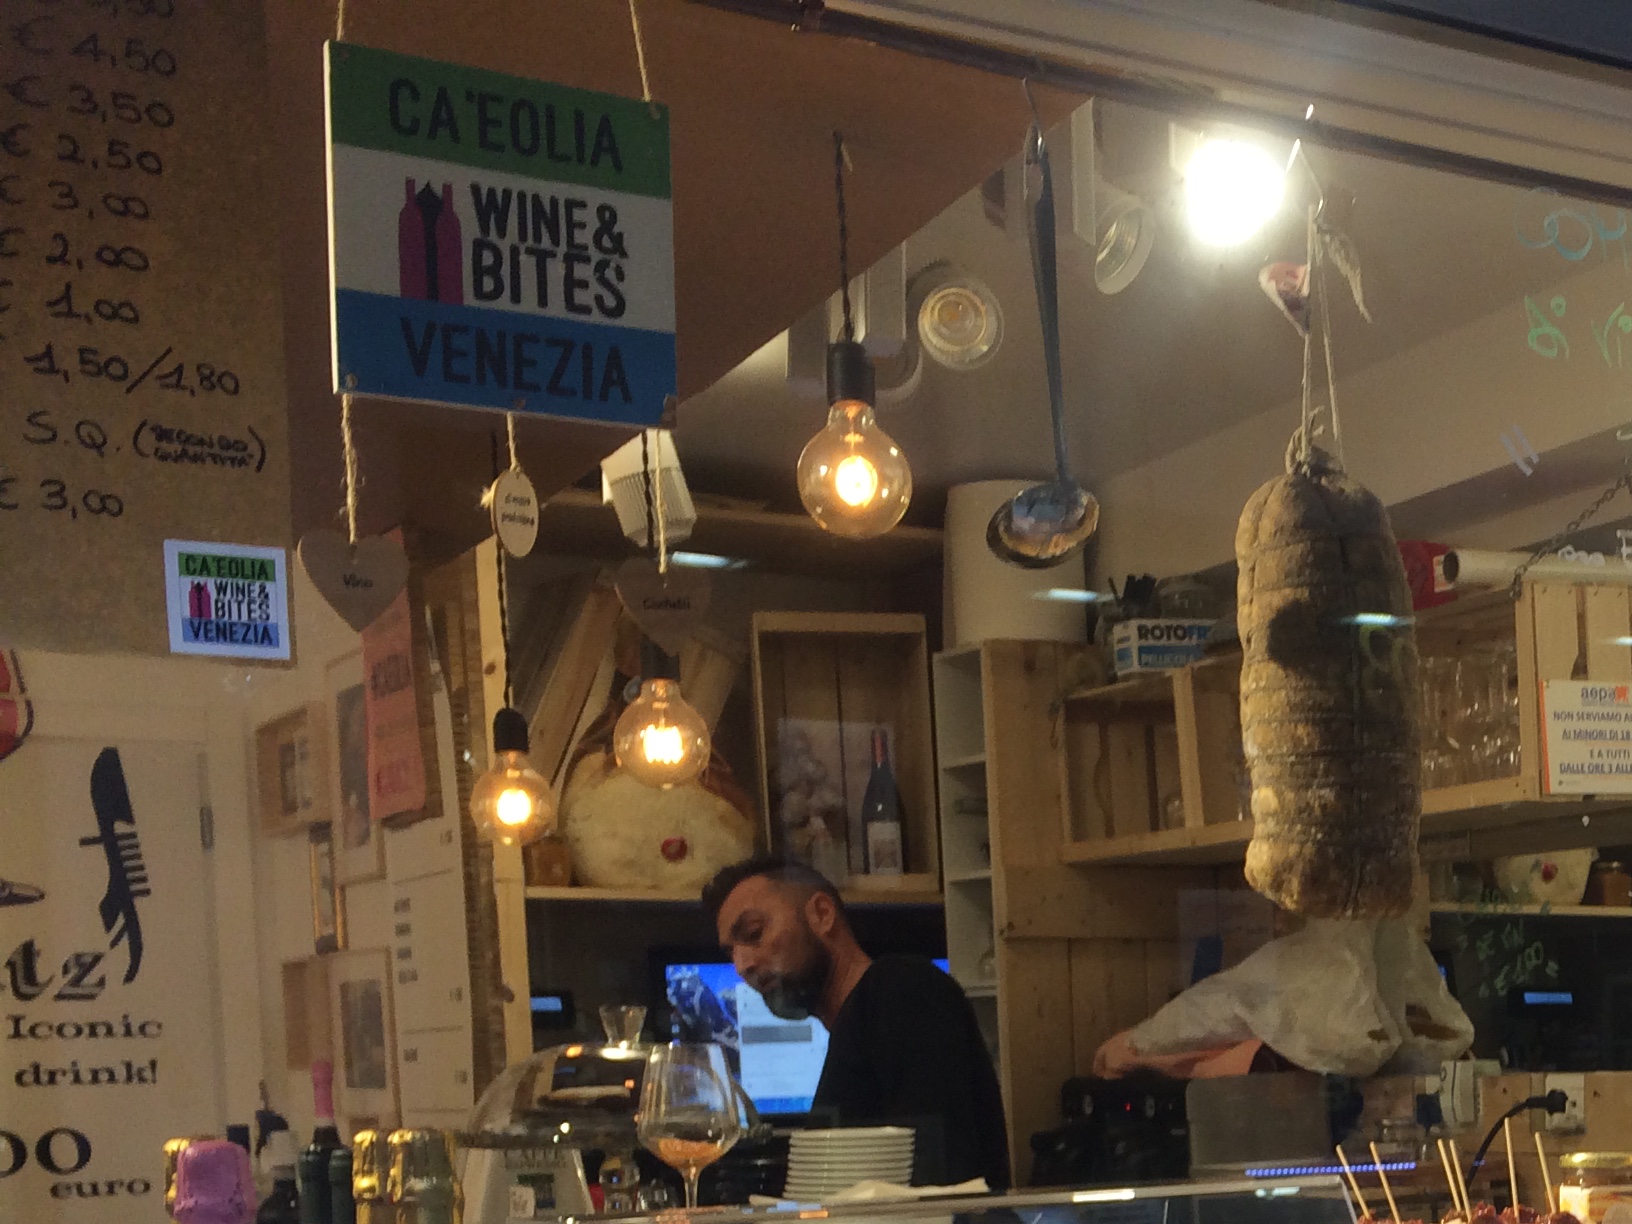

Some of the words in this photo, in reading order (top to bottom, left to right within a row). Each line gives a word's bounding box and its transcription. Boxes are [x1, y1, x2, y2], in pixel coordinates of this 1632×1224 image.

[70, 33, 177, 77] 4,50
[66, 83, 175, 128] 3,50
[388, 77, 624, 173] CA'EOLIA
[57, 133, 163, 176] 2,50
[48, 180, 150, 220] 3,00
[471, 182, 628, 258] WINE&
[46, 232, 150, 272] 2,00
[471, 245, 627, 318] BITES
[46, 281, 140, 325] 1,00
[401, 317, 633, 405] VENEZIA
[40, 478, 124, 519] 3,00
[184, 553, 269, 580] CA'EOLIA
[214, 600, 270, 622] BITES
[189, 618, 274, 646] VENEZIA
[1553, 711, 1574, 721] NON
[1576, 711, 1622, 722] SERVIAMO
[1560, 762, 1586, 774] DALLE
[6, 1013, 163, 1041] Iconic
[14, 1060, 157, 1087] drink!
[50, 1179, 152, 1201] euro
